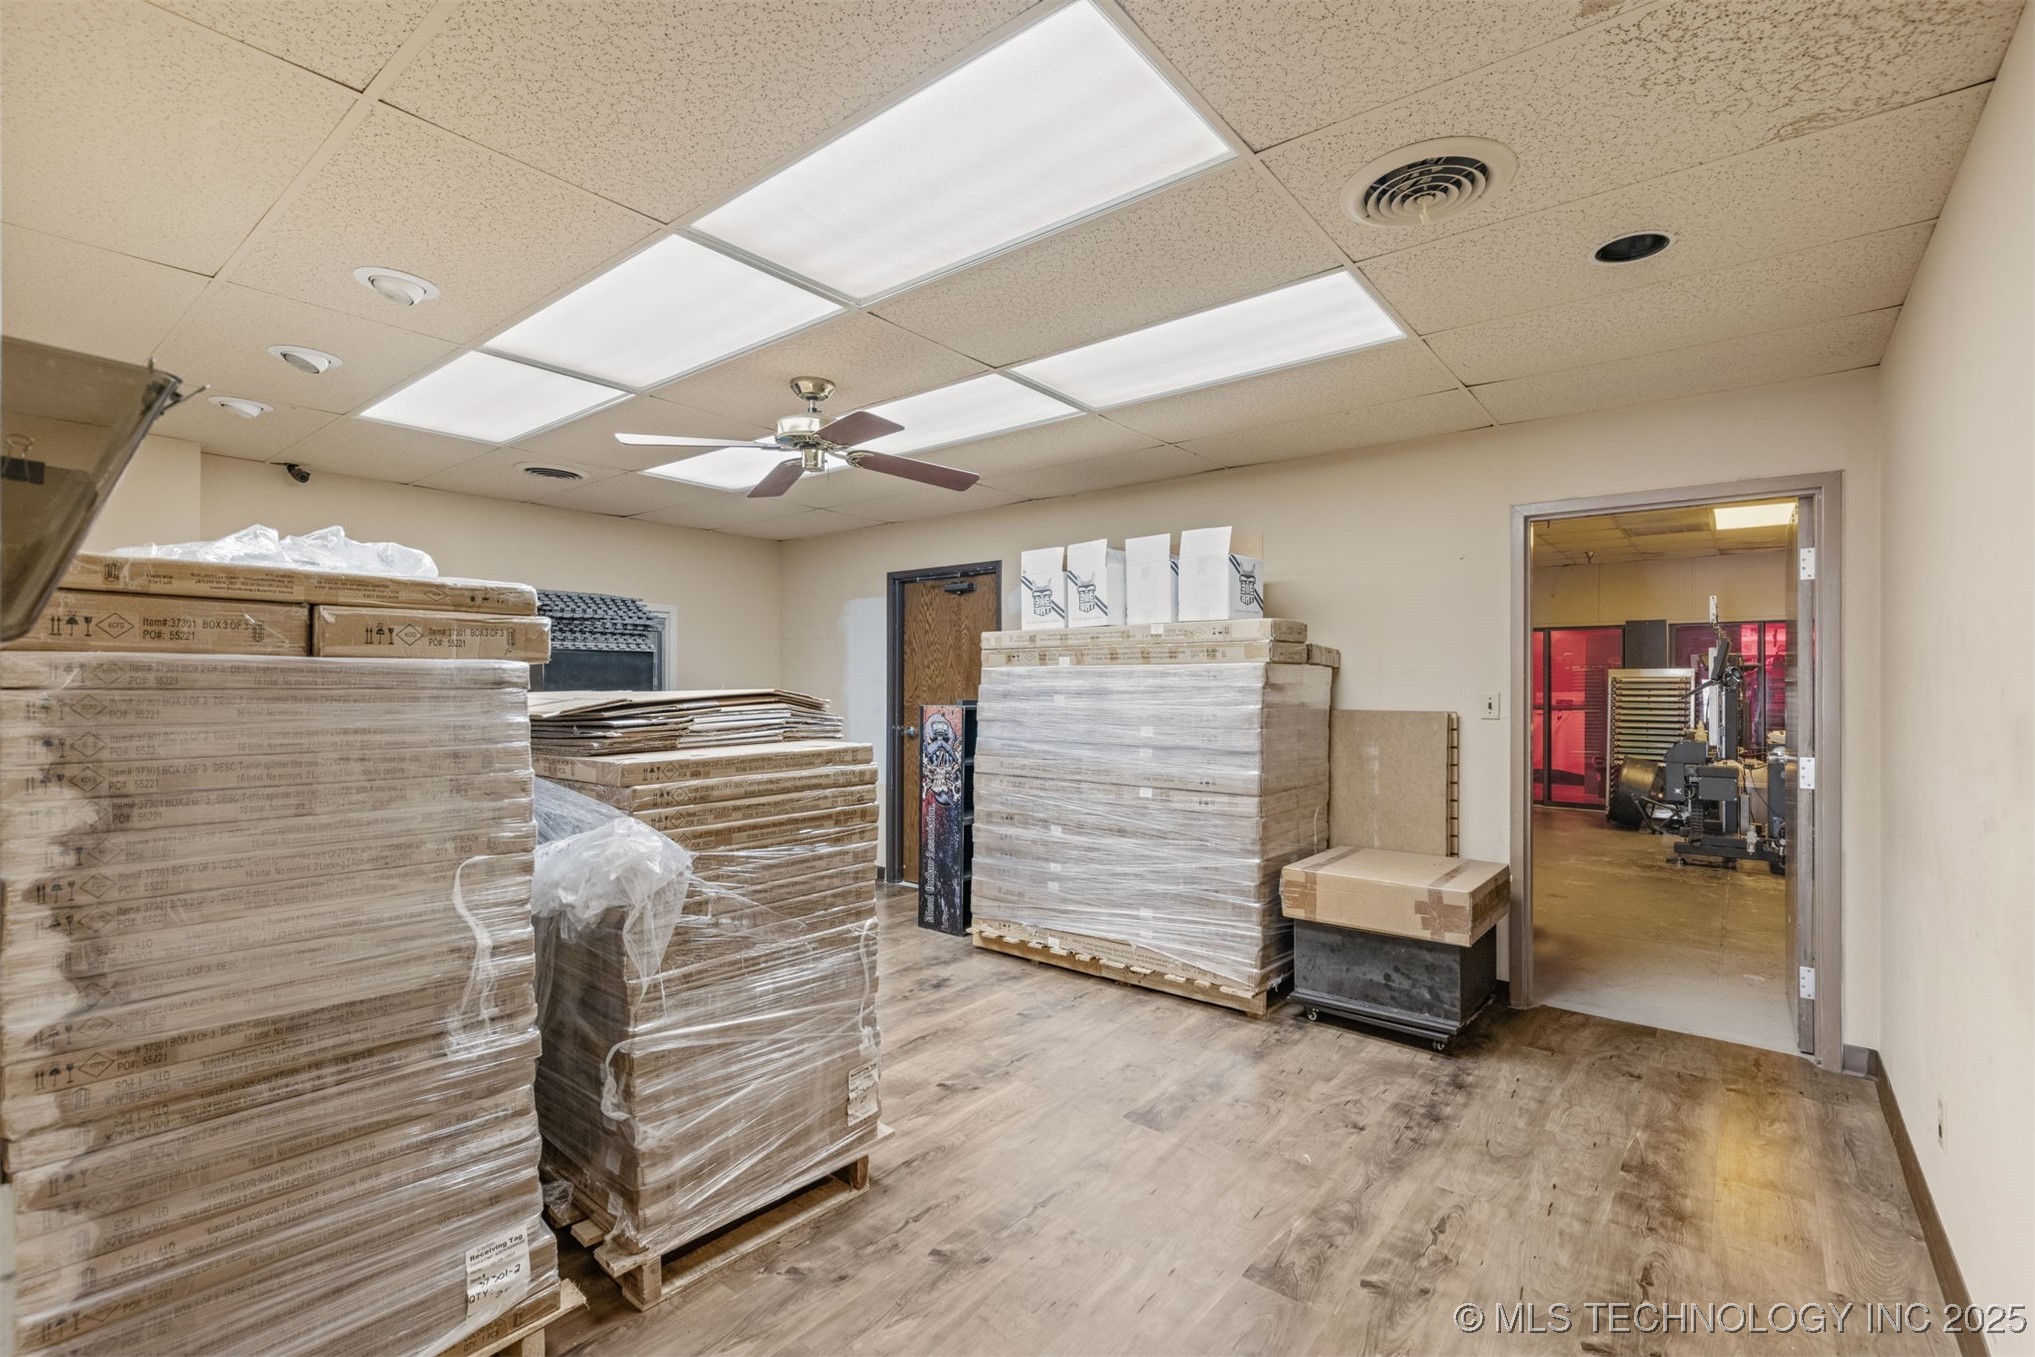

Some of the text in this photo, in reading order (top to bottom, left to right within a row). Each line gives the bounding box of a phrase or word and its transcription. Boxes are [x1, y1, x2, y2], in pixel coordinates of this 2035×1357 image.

[202, 618, 221, 629] BOX
[222, 620, 228, 630] 3
[230, 620, 243, 631] OF
[243, 621, 250, 631] 3
[142, 629, 195, 641] PO#: 55221
[470, 628, 485, 638] BOX
[490, 628, 500, 638] OF
[447, 638, 466, 648] 55221
[154, 676, 178, 685] 55221
[134, 778, 159, 789] 55221
[470, 1241, 508, 1262] Receiving
[509, 1233, 524, 1244] Tag
